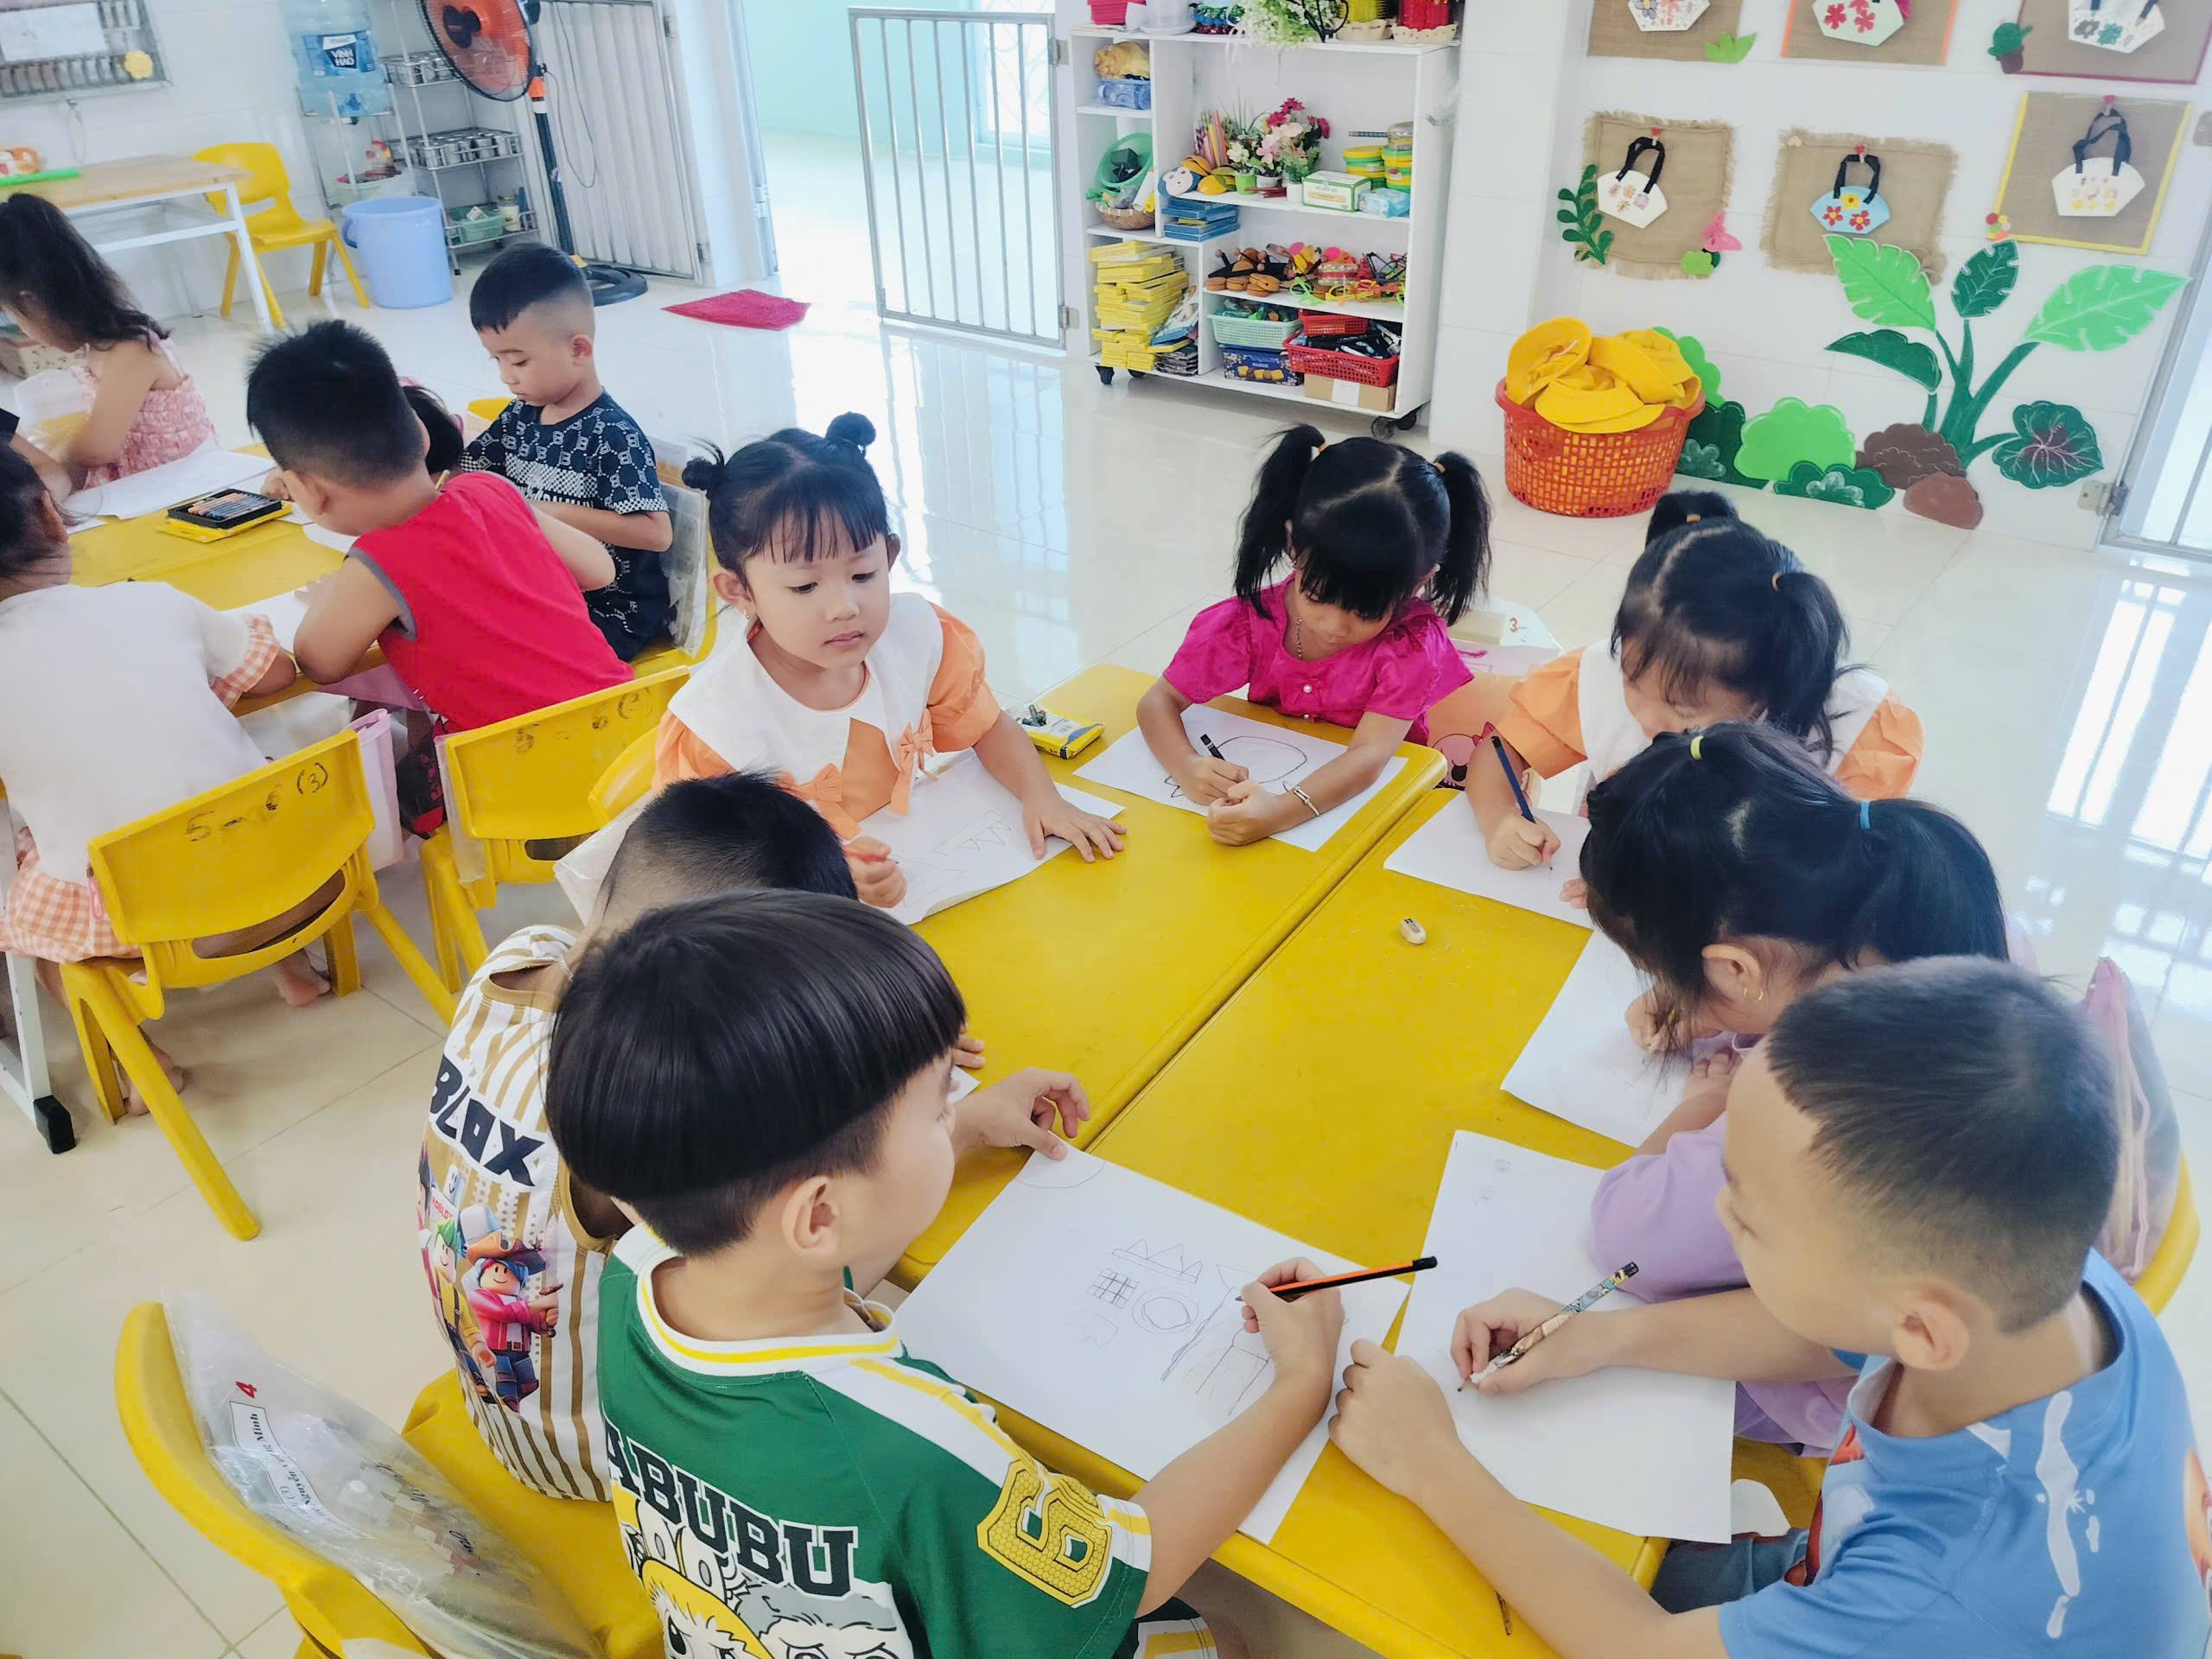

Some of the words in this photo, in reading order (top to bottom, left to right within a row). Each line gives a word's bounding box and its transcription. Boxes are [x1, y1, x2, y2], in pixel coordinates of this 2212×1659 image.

[296, 762, 328, 794] (3)
[429, 1053, 545, 1187] BLOX
[235, 1381, 257, 1399] 4
